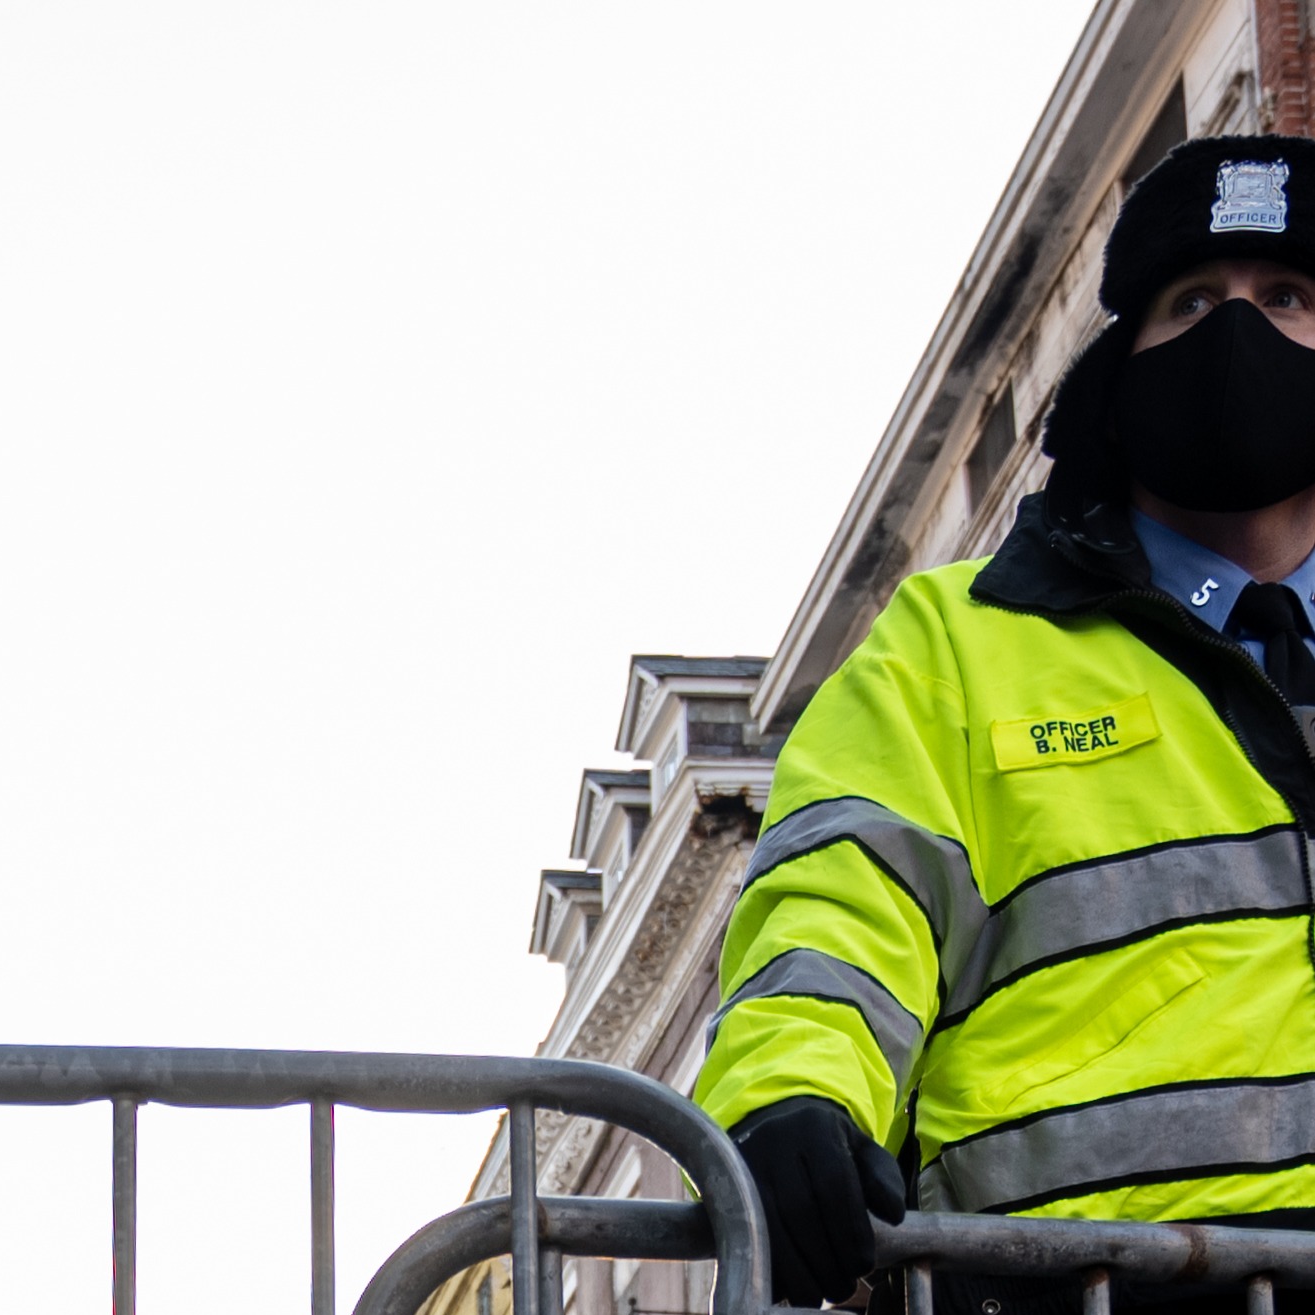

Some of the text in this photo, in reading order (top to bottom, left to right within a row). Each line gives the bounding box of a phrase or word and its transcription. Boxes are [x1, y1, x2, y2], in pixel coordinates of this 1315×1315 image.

[1220, 212, 1277, 224] OFFICER
[1190, 578, 1219, 607] 5
[1030, 715, 1116, 740] OFFICER
[1035, 733, 1119, 754] B. NEAL
